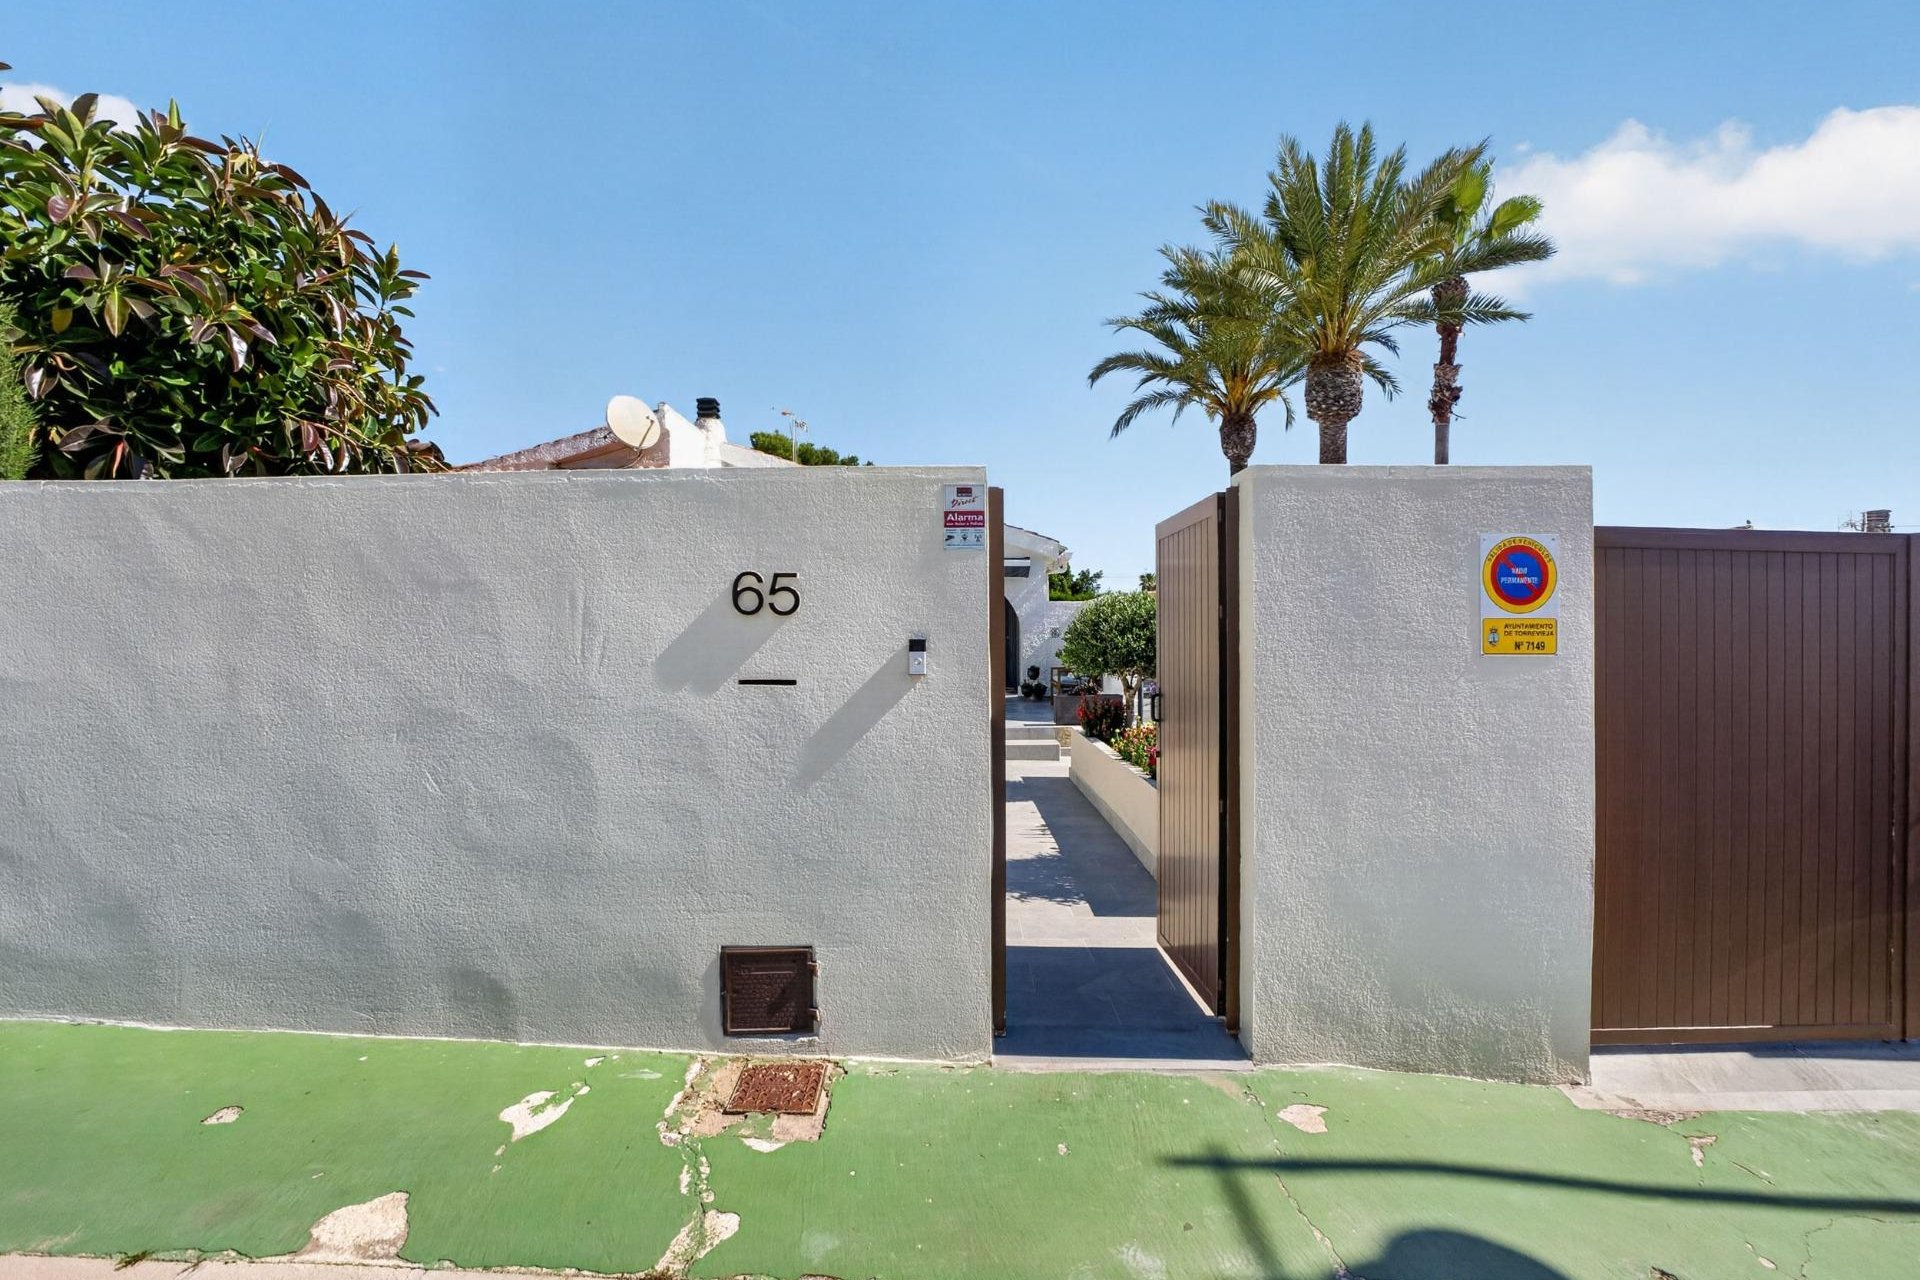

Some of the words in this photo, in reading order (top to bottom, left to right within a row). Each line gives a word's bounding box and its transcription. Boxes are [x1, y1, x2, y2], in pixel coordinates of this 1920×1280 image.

[947, 513, 984, 521] Alarma
[732, 571, 800, 616] 65
[1525, 641, 1545, 650] 7149
